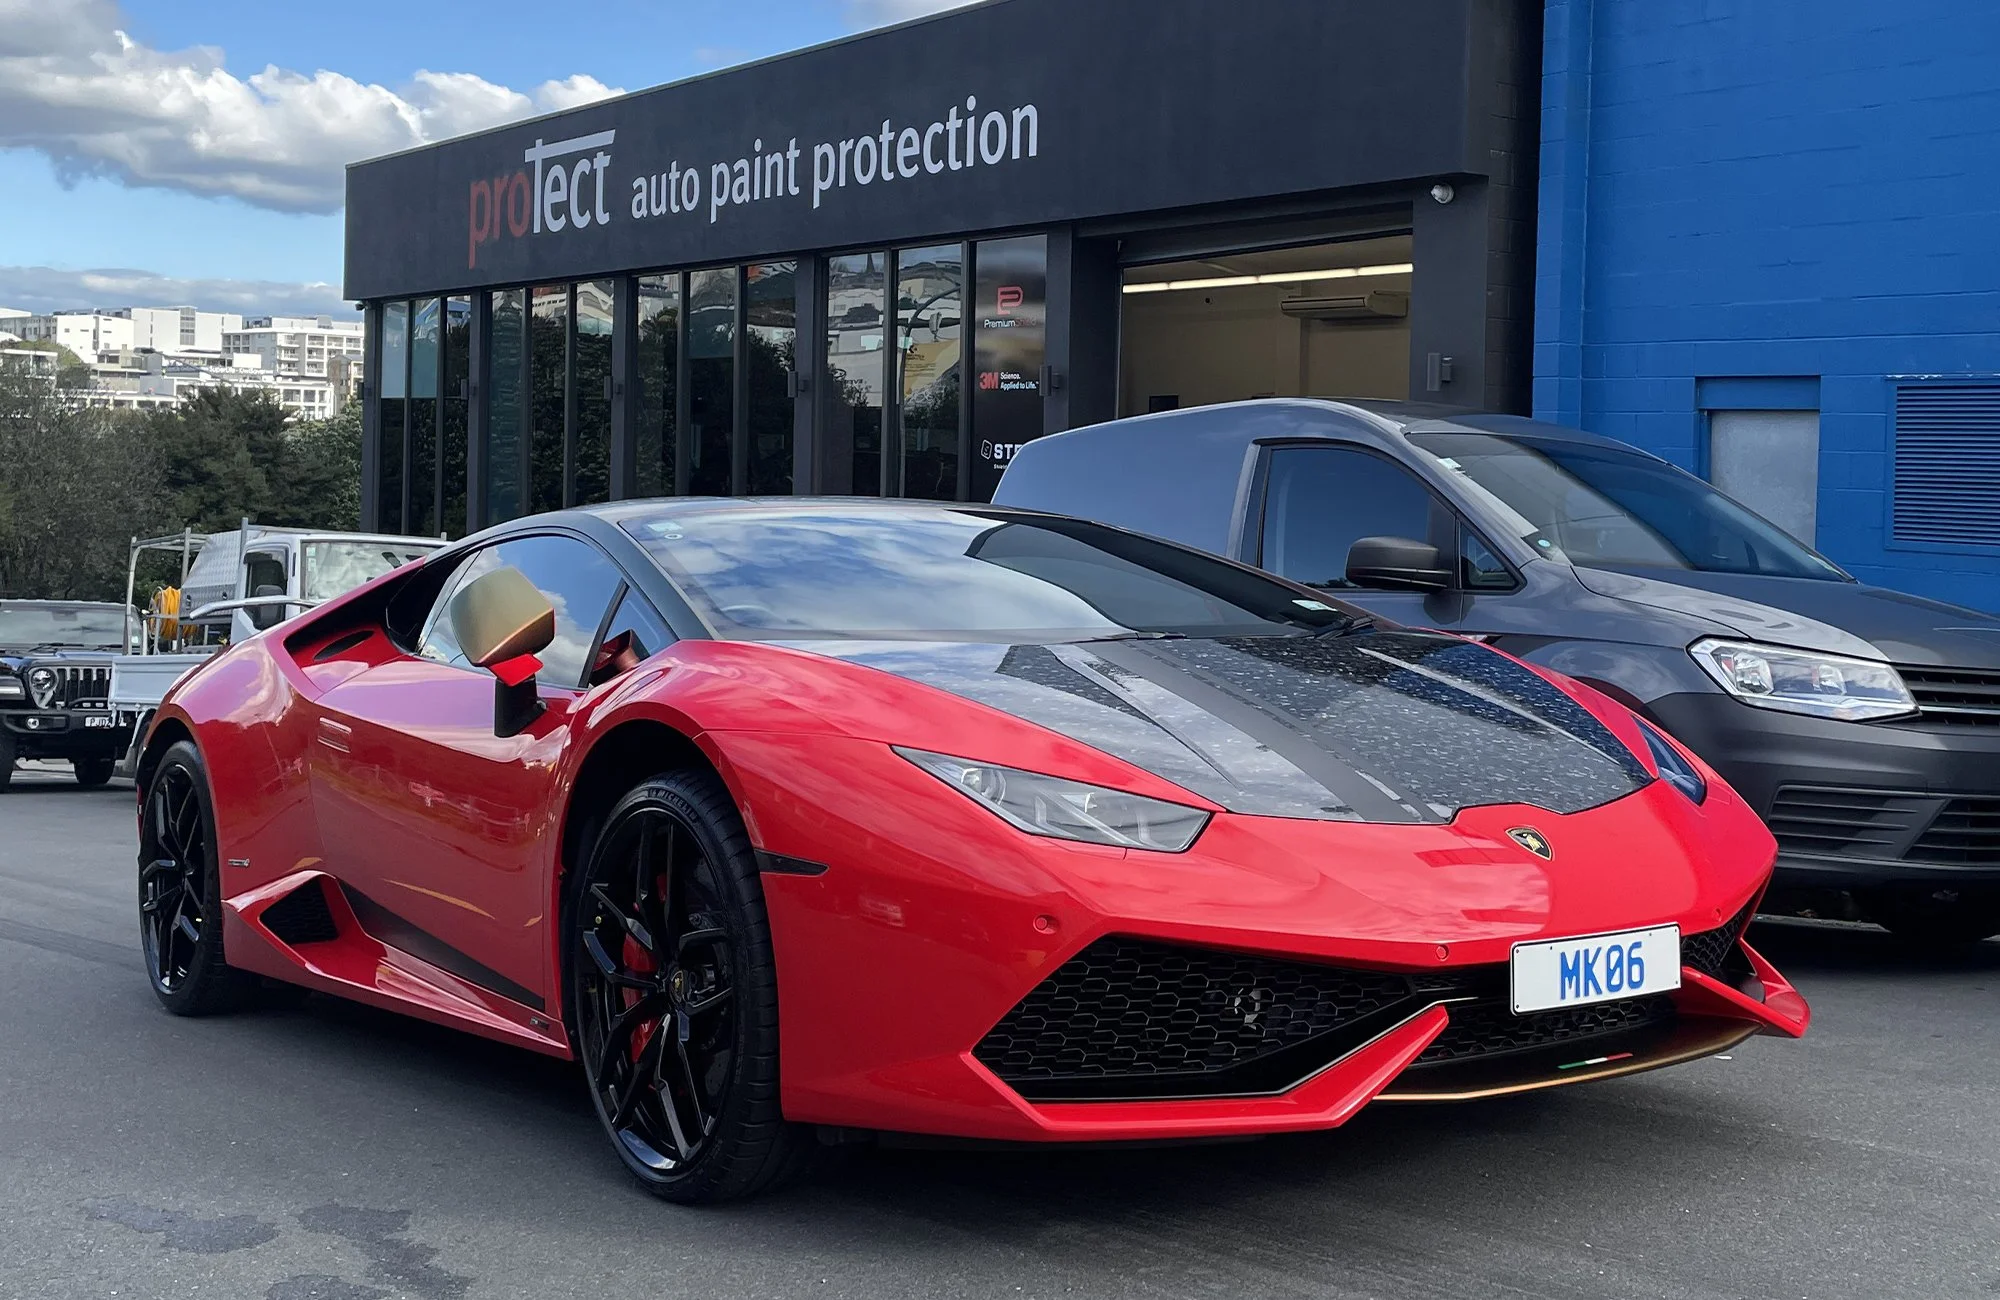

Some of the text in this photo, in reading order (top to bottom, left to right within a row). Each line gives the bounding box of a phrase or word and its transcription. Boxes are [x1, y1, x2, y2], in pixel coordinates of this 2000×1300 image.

[631, 160, 700, 219] auto
[710, 138, 801, 223] paint
[813, 95, 1039, 209] protection
[980, 372, 999, 390] 3M
[1000, 381, 1019, 391] Applied
[1560, 941, 1645, 1000] MK06
